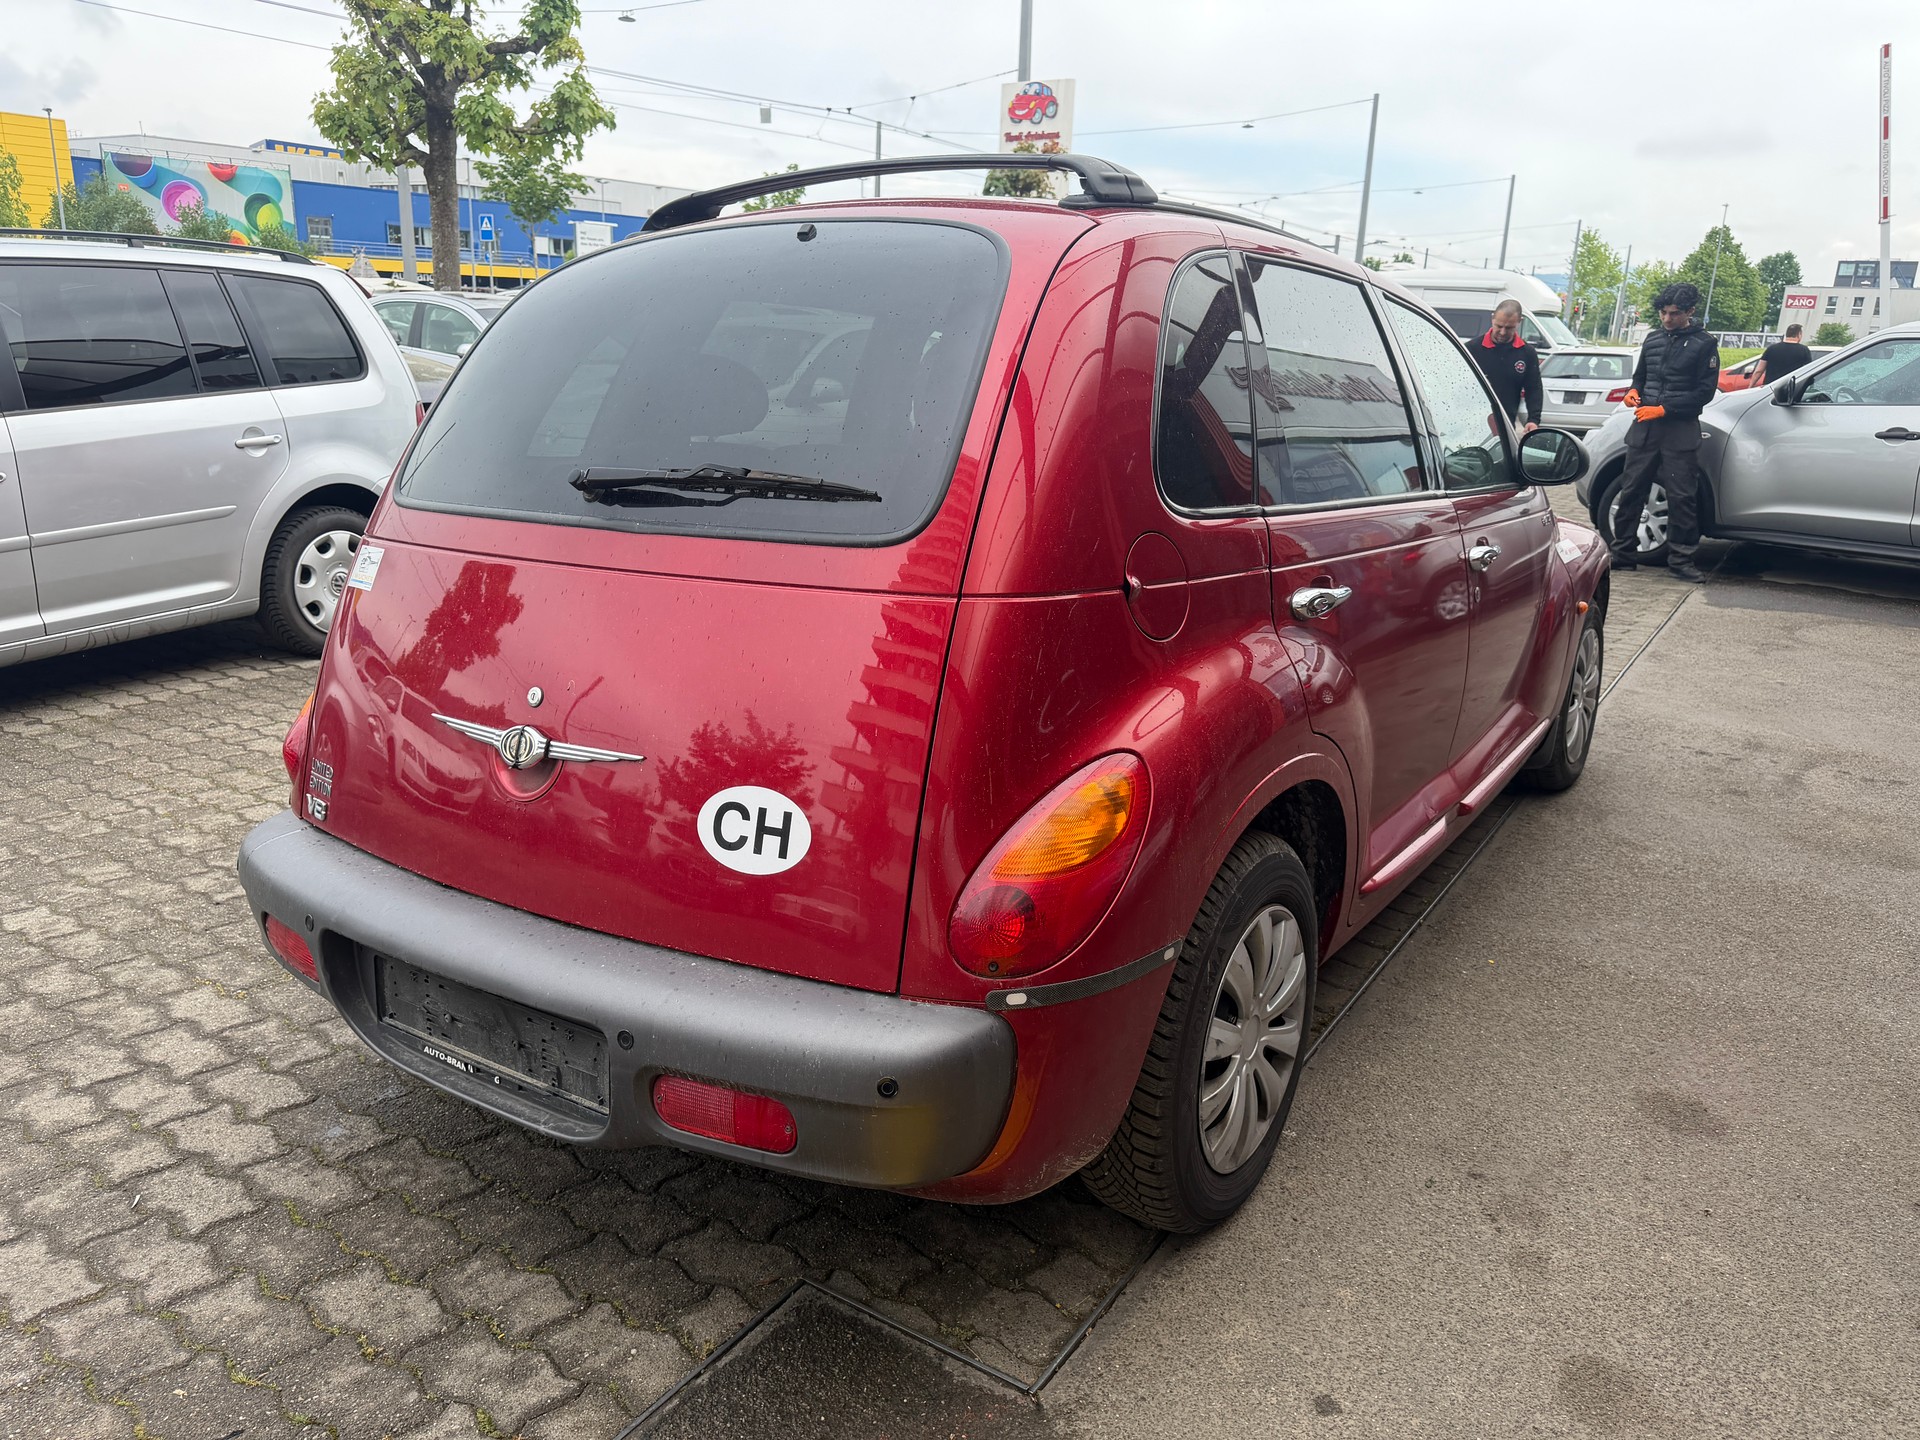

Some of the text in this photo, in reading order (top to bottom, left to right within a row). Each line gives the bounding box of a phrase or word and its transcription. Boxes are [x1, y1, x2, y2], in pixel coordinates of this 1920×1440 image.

[1787, 298, 1815, 306] PANO
[311, 757, 333, 779] LIMITED
[310, 775, 332, 798] EDITION
[713, 801, 793, 860] CH
